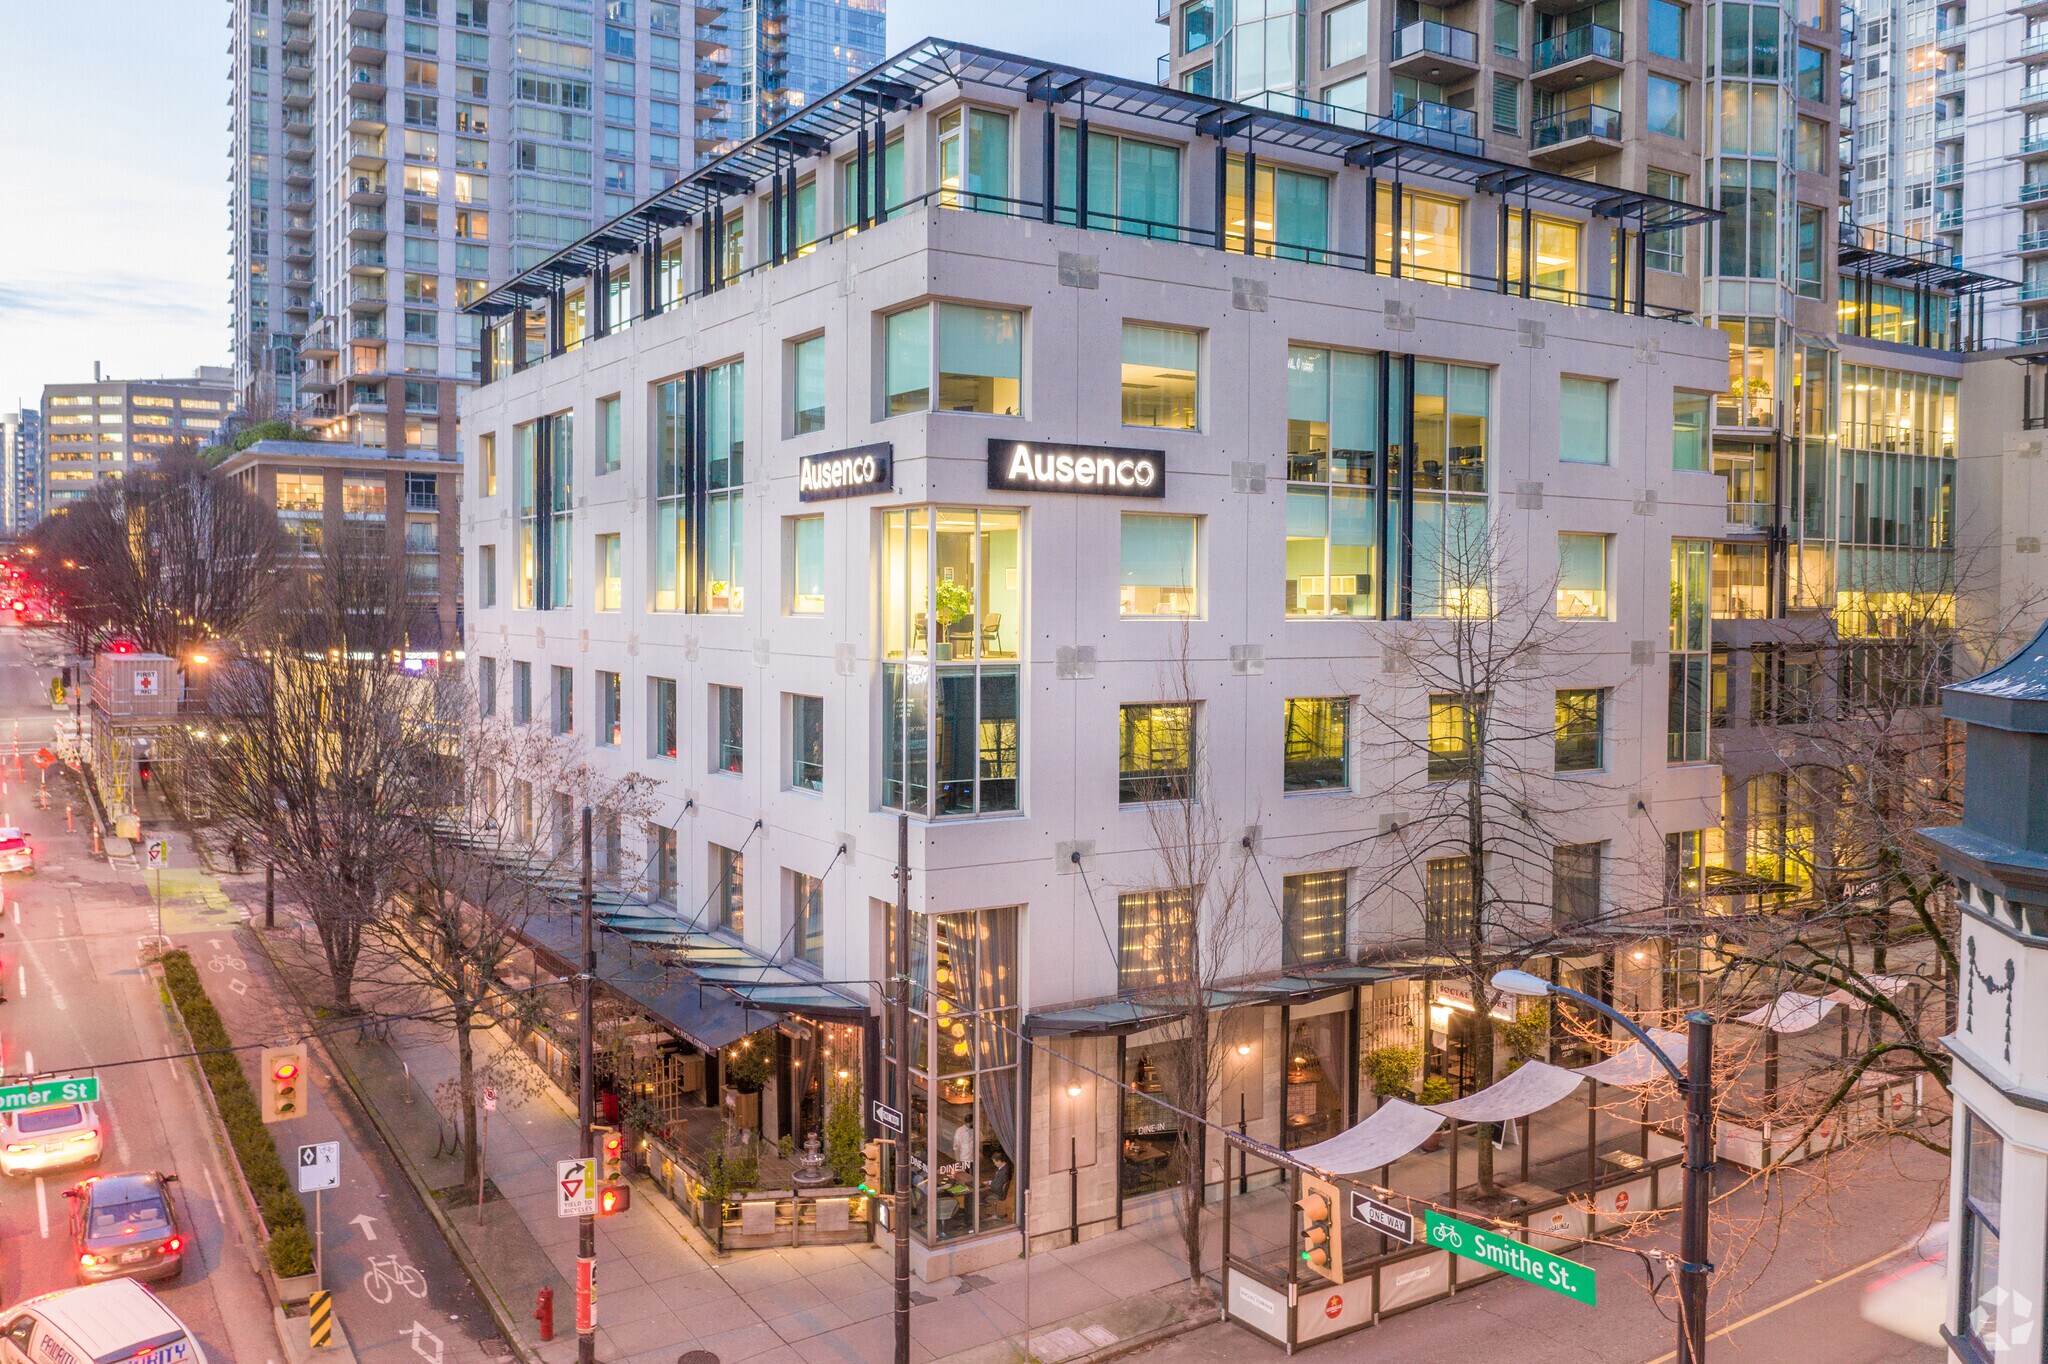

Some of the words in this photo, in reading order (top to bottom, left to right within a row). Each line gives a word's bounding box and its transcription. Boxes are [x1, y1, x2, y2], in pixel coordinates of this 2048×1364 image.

[800, 456, 875, 492] Ausenco
[1008, 444, 1155, 487] Ausenco
[1440, 985, 1469, 999] SOCIAL
[62, 1083, 88, 1101] St
[1138, 1122, 1165, 1135] DINE-IN
[940, 1161, 970, 1175] DINE-IN
[563, 1206, 593, 1214] BICYCLES
[1369, 1208, 1384, 1223] ONE
[1387, 1215, 1404, 1231] WAY
[1474, 1235, 1544, 1280] Smithe
[1548, 1261, 1577, 1293] St.
